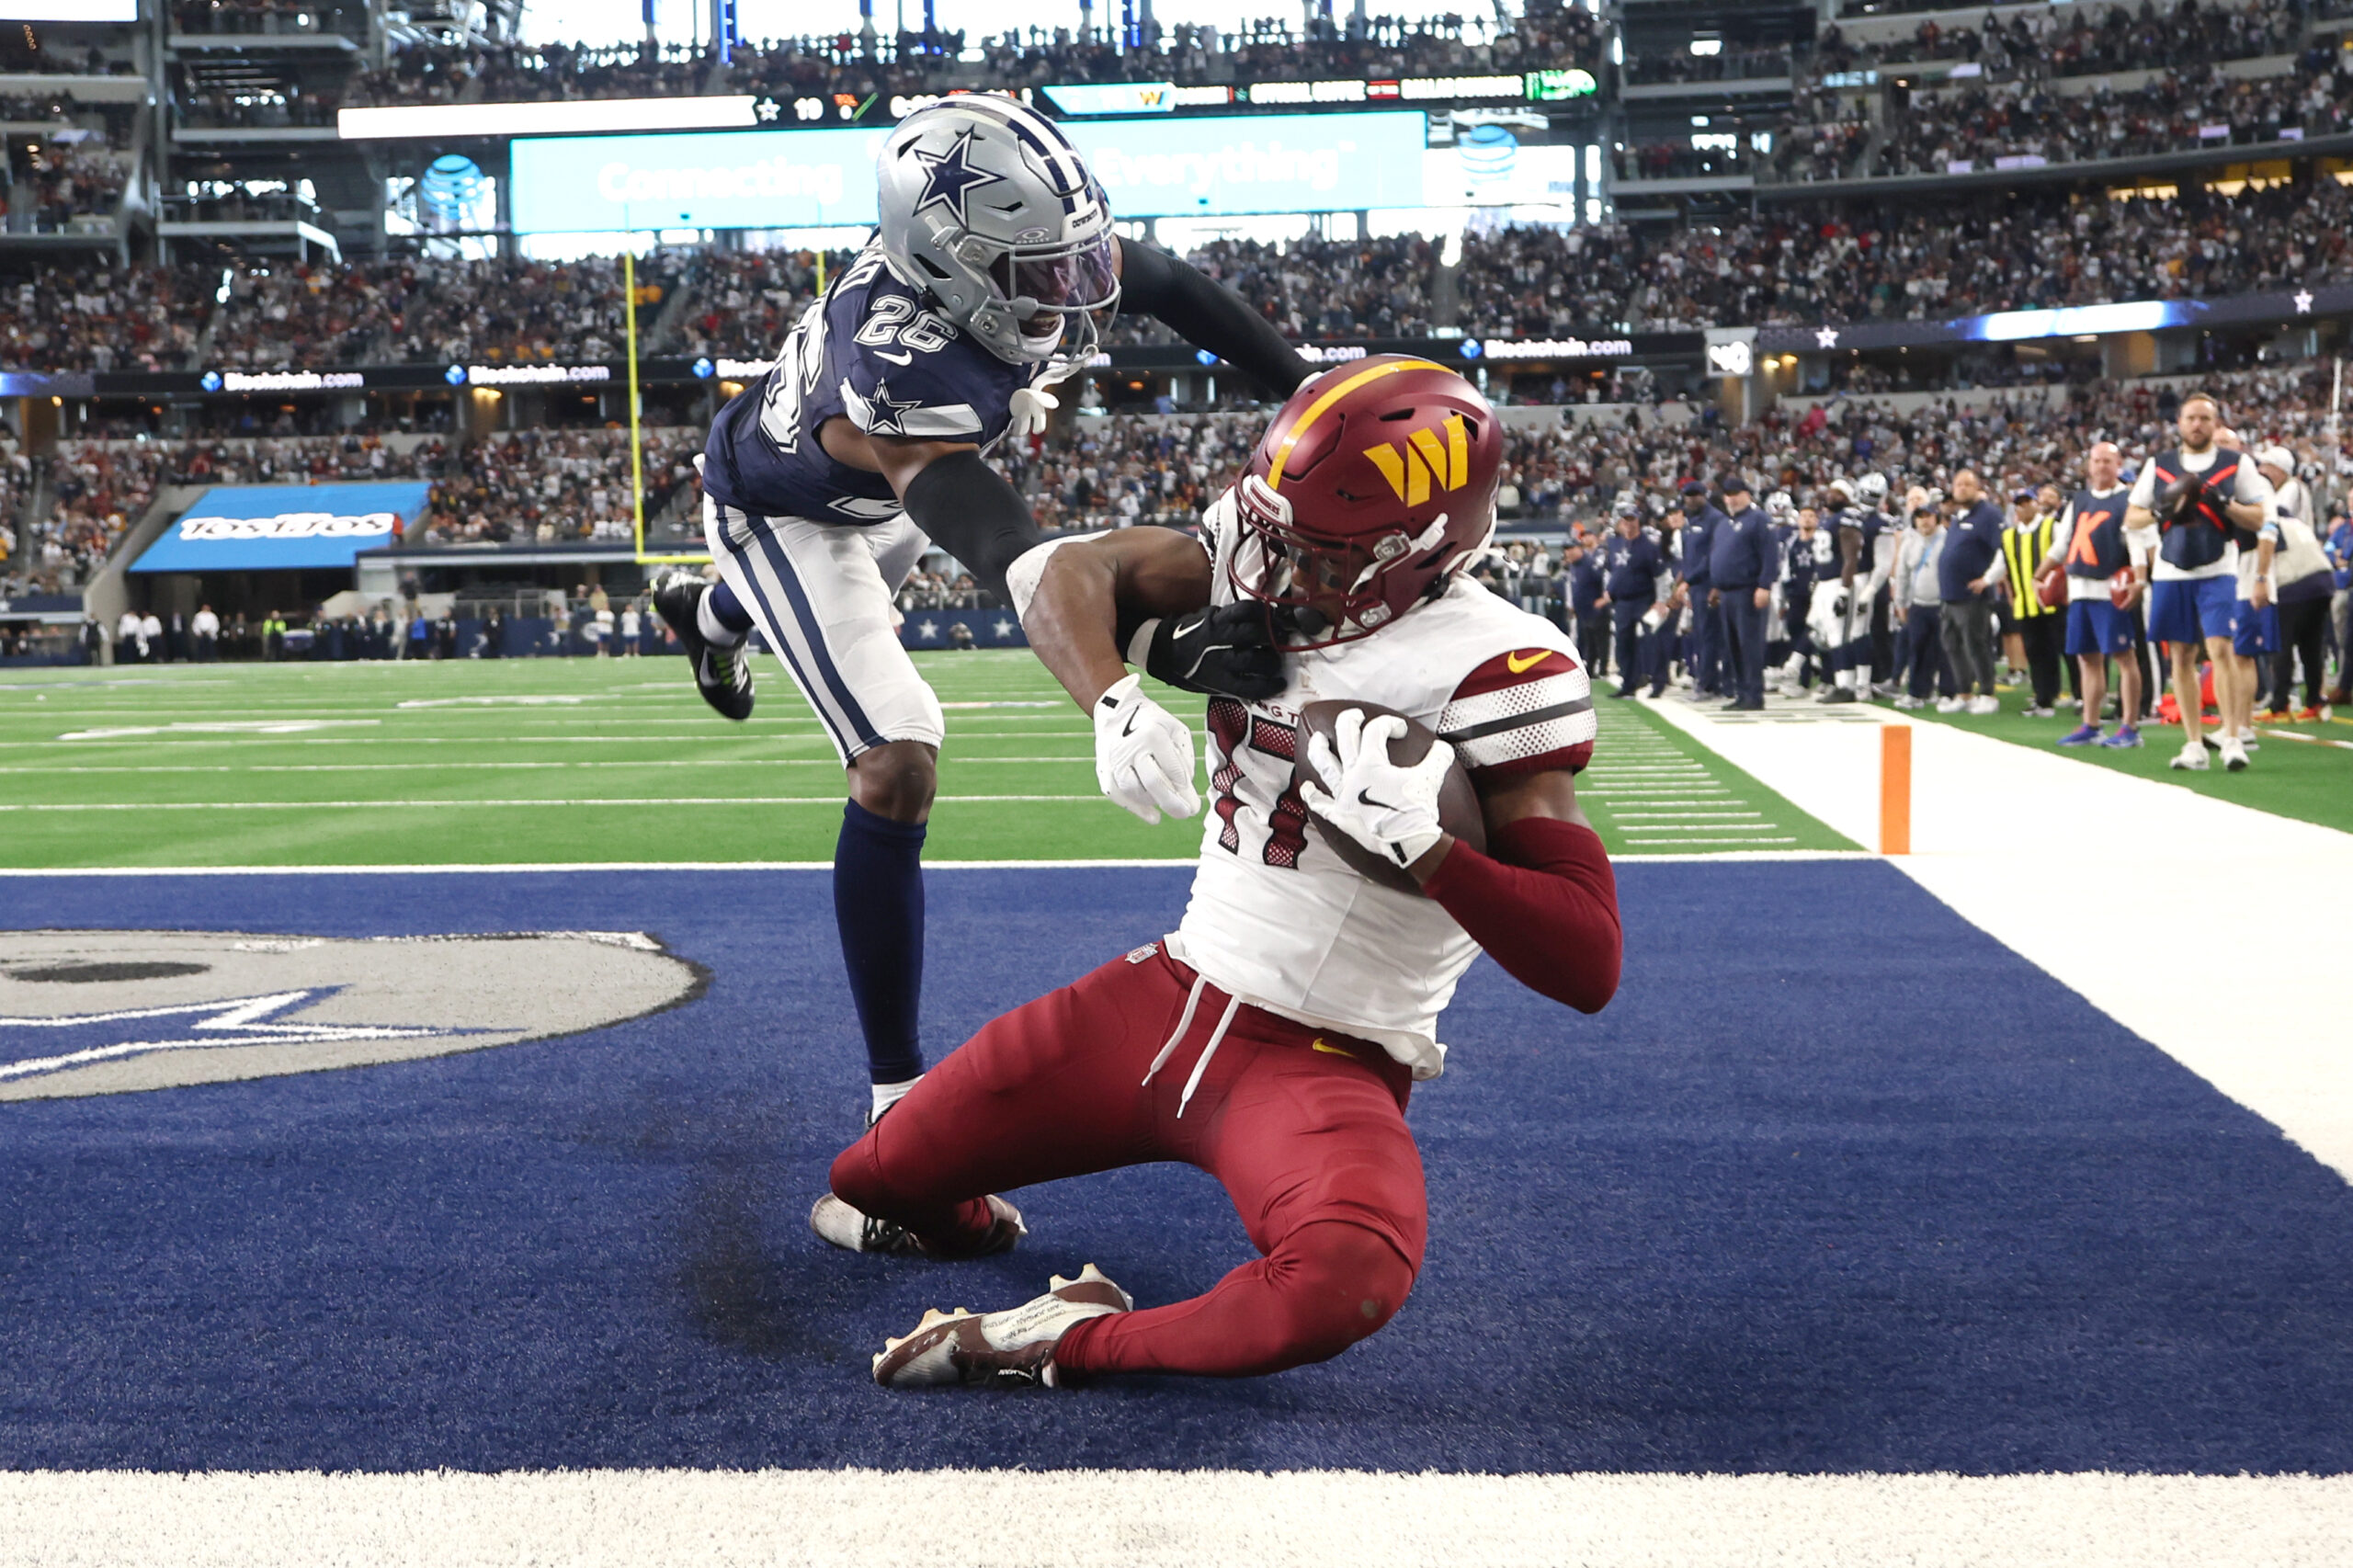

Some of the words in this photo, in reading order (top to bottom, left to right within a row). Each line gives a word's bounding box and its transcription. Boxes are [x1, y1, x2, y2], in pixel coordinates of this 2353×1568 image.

[597, 153, 843, 205] Connecting
[854, 294, 959, 353] 26
[1483, 336, 1632, 359] Blockchain.com
[223, 369, 364, 392] Blockchain.com
[468, 362, 610, 385] Blockchain.com
[2068, 509, 2112, 566] K
